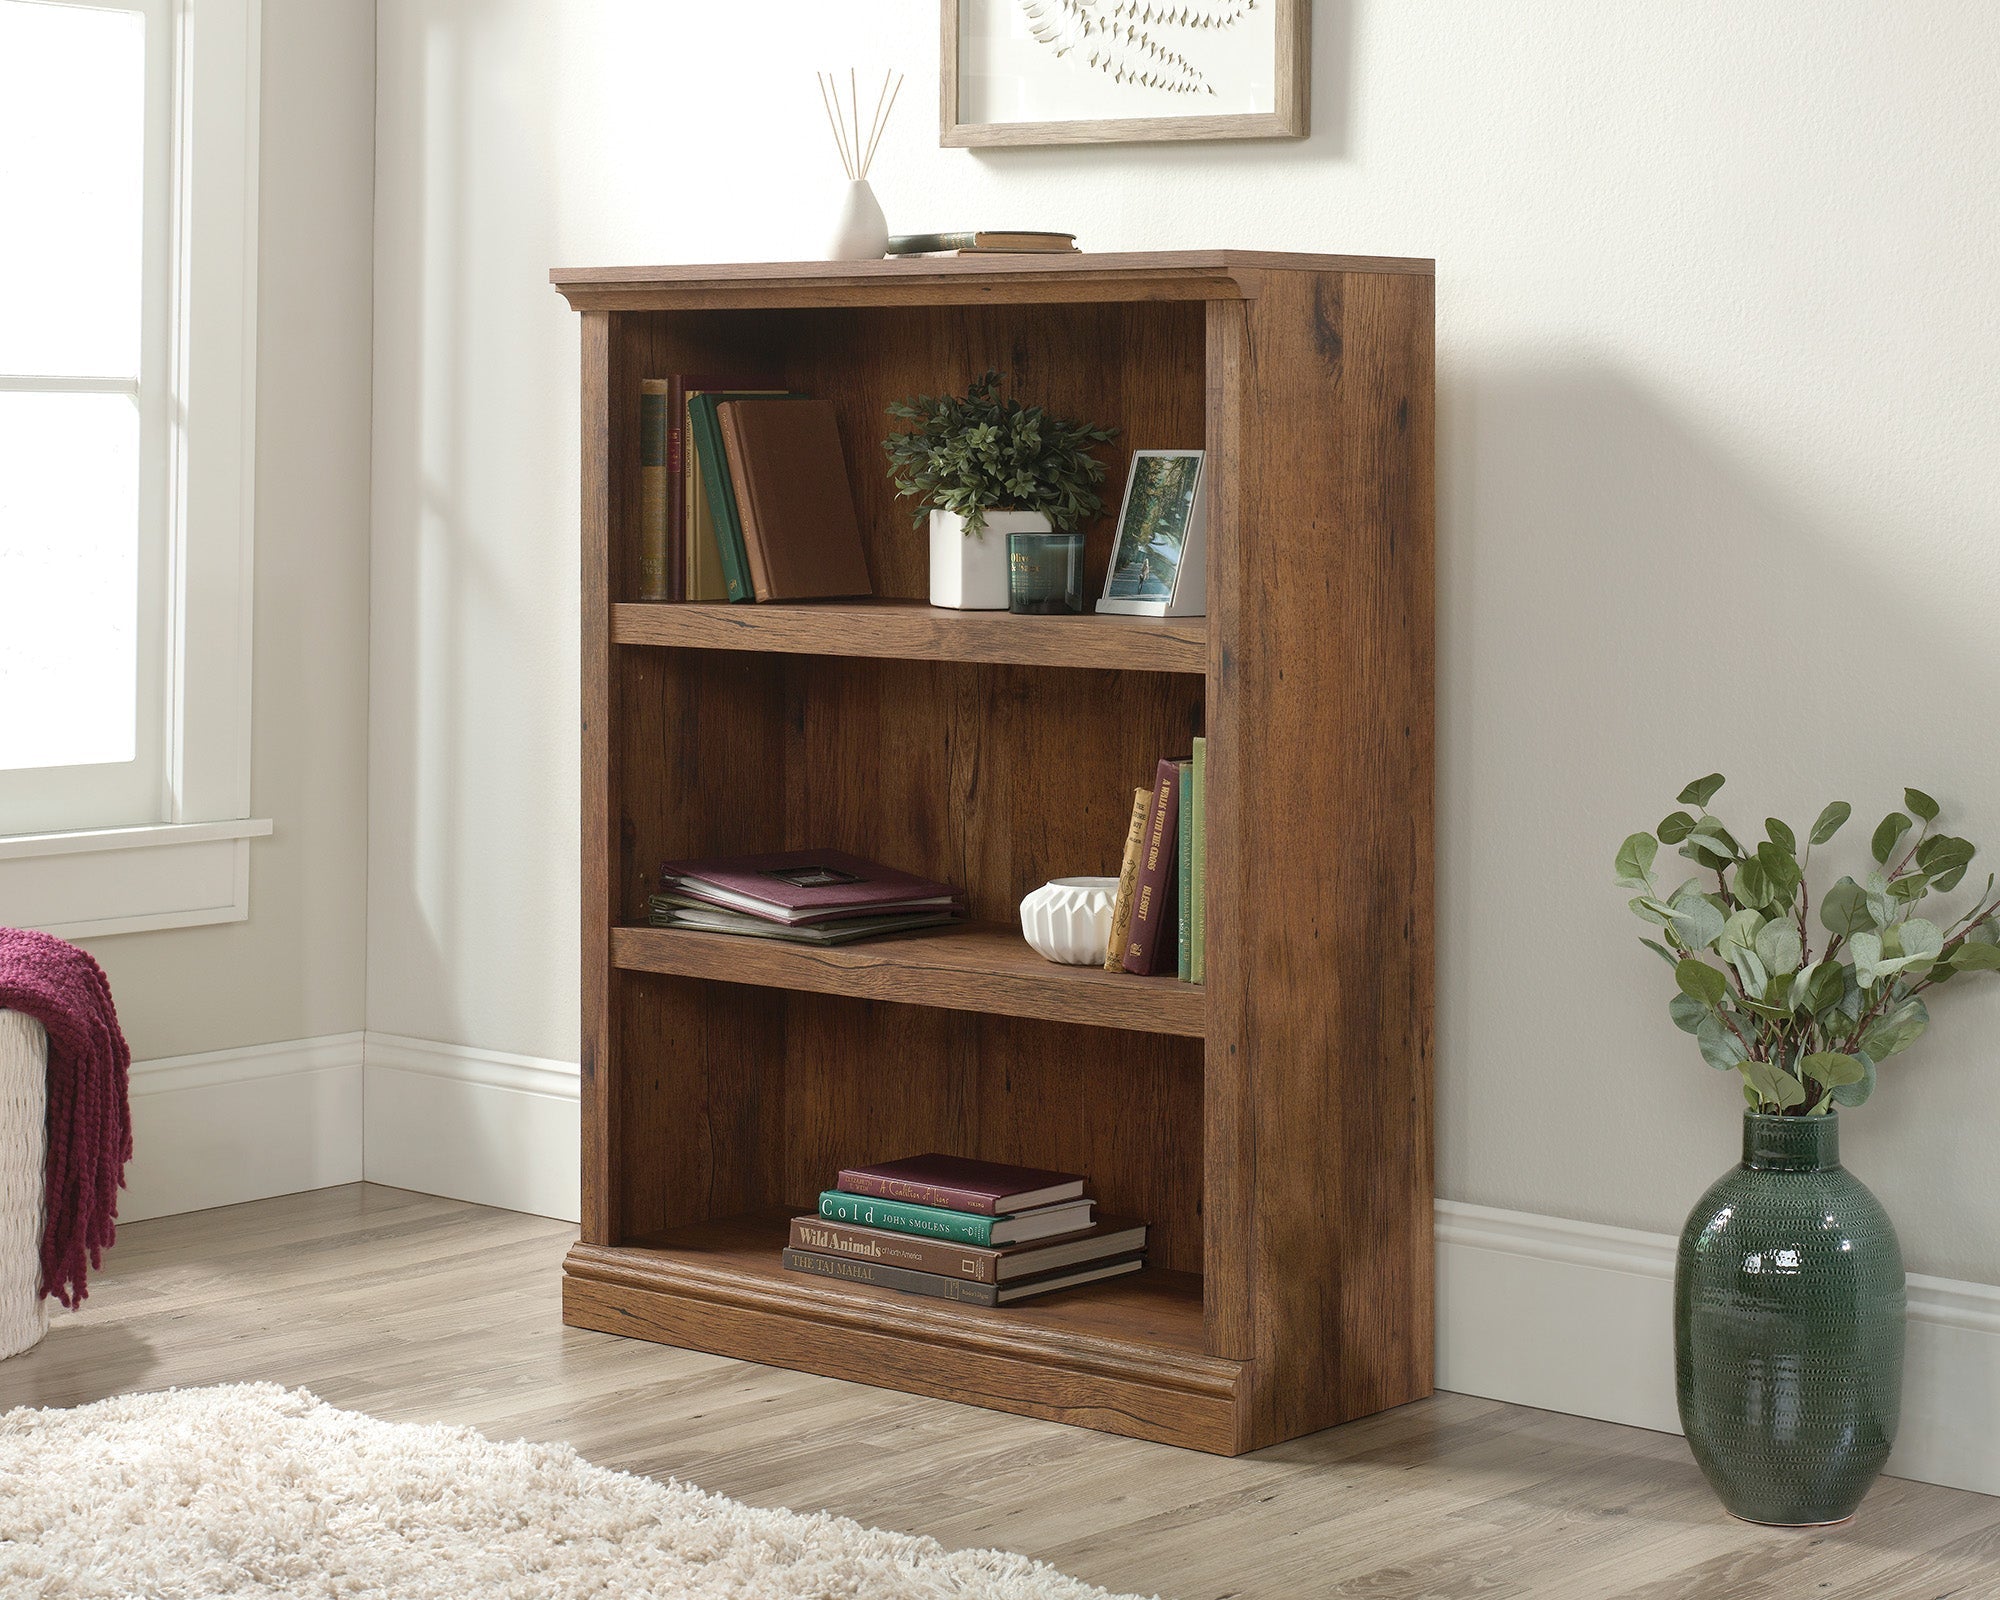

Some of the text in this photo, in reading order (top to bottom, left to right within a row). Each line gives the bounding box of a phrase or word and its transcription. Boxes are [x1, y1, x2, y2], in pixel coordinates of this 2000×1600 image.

[1147, 778, 1171, 872] A WALK WITH THE CROSS
[1183, 800, 1191, 870] COUNTRYMAN
[1137, 885, 1152, 921] BLESSITT
[1183, 885, 1191, 923] SUMMARY
[1183, 926, 1191, 937] OF
[880, 1179, 886, 1194] A
[889, 1180, 920, 1200] Coalition
[922, 1187, 931, 1200] of
[821, 1198, 875, 1224] Cold
[883, 1213, 951, 1233] JOHN SMOLENS
[799, 1226, 829, 1248] Wild
[829, 1232, 882, 1258] Animals
[887, 1247, 901, 1257] North
[901, 1250, 923, 1261] America
[792, 1254, 875, 1281] THE TAJ MAHAL
